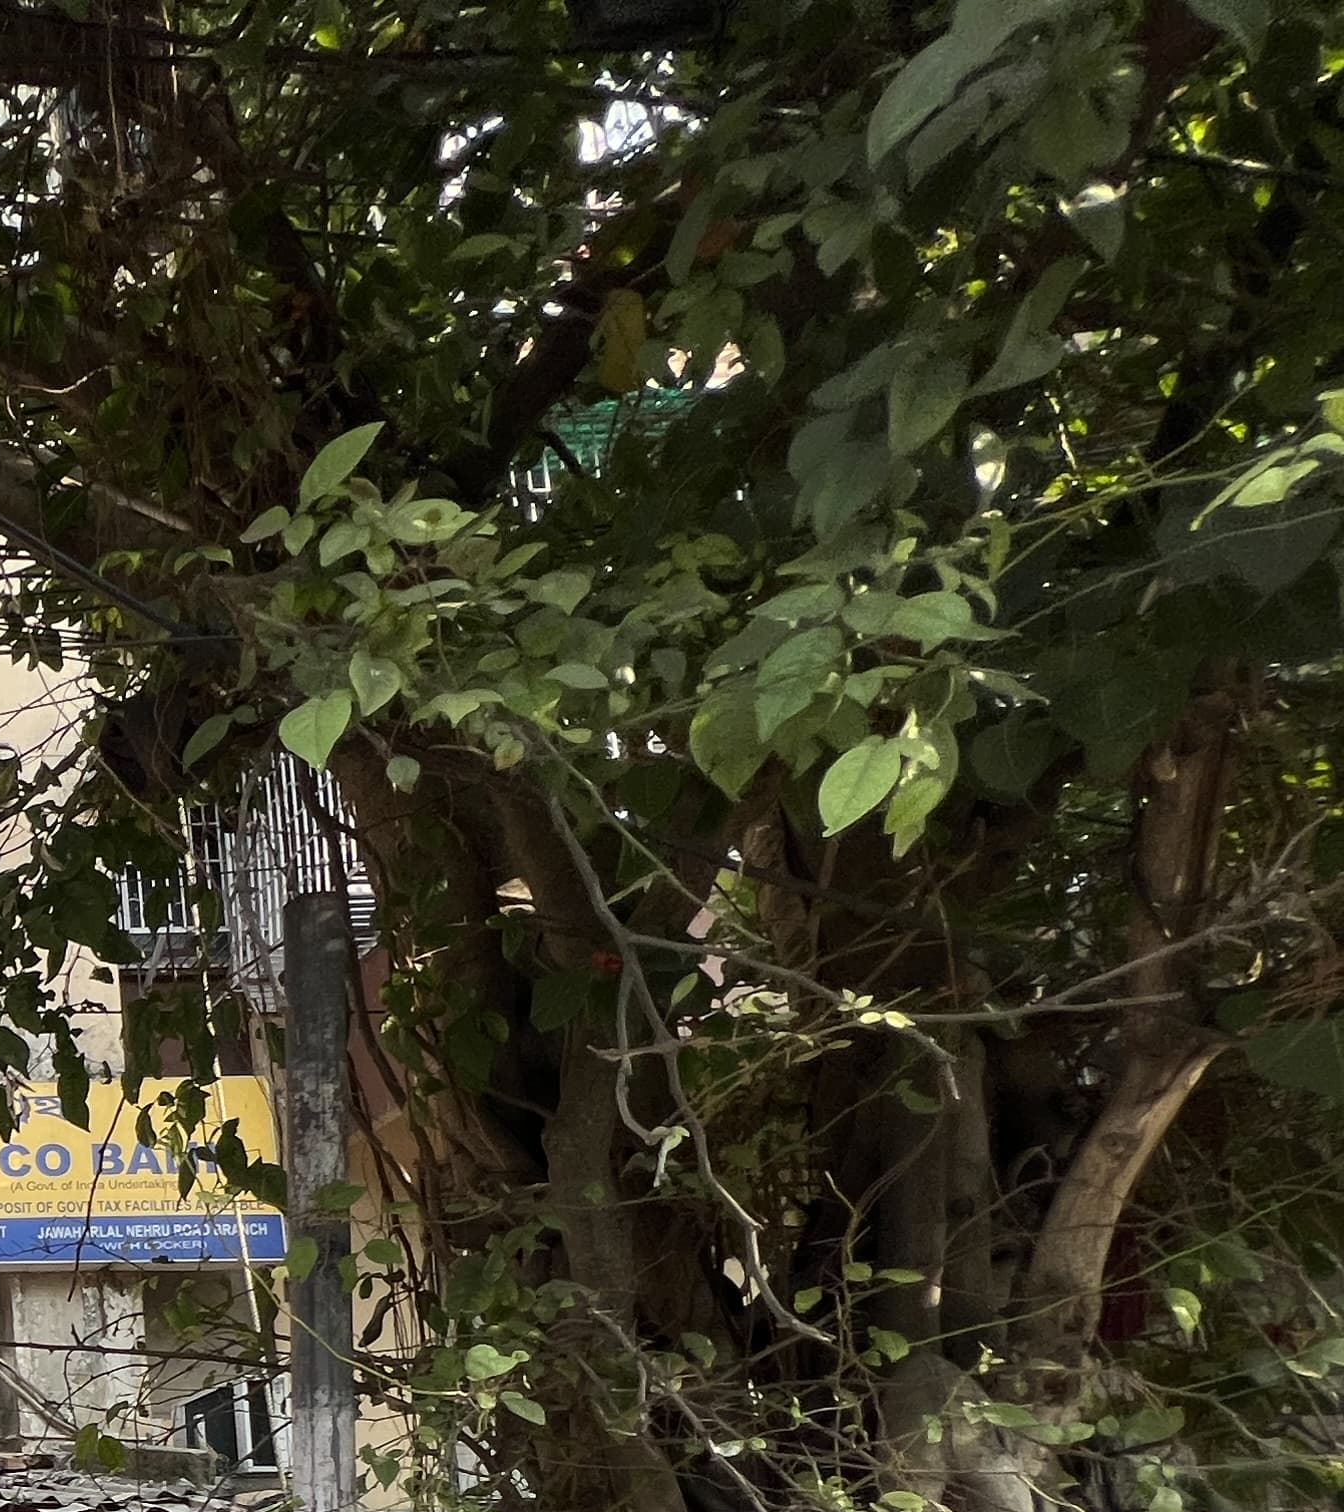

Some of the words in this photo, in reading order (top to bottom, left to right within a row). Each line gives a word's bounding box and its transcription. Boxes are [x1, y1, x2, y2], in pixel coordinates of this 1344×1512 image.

[62, 1180, 73, 1190] of
[36, 1201, 53, 1213] OF
[98, 1200, 121, 1212] TAX
[126, 1224, 171, 1237] NEHRU
